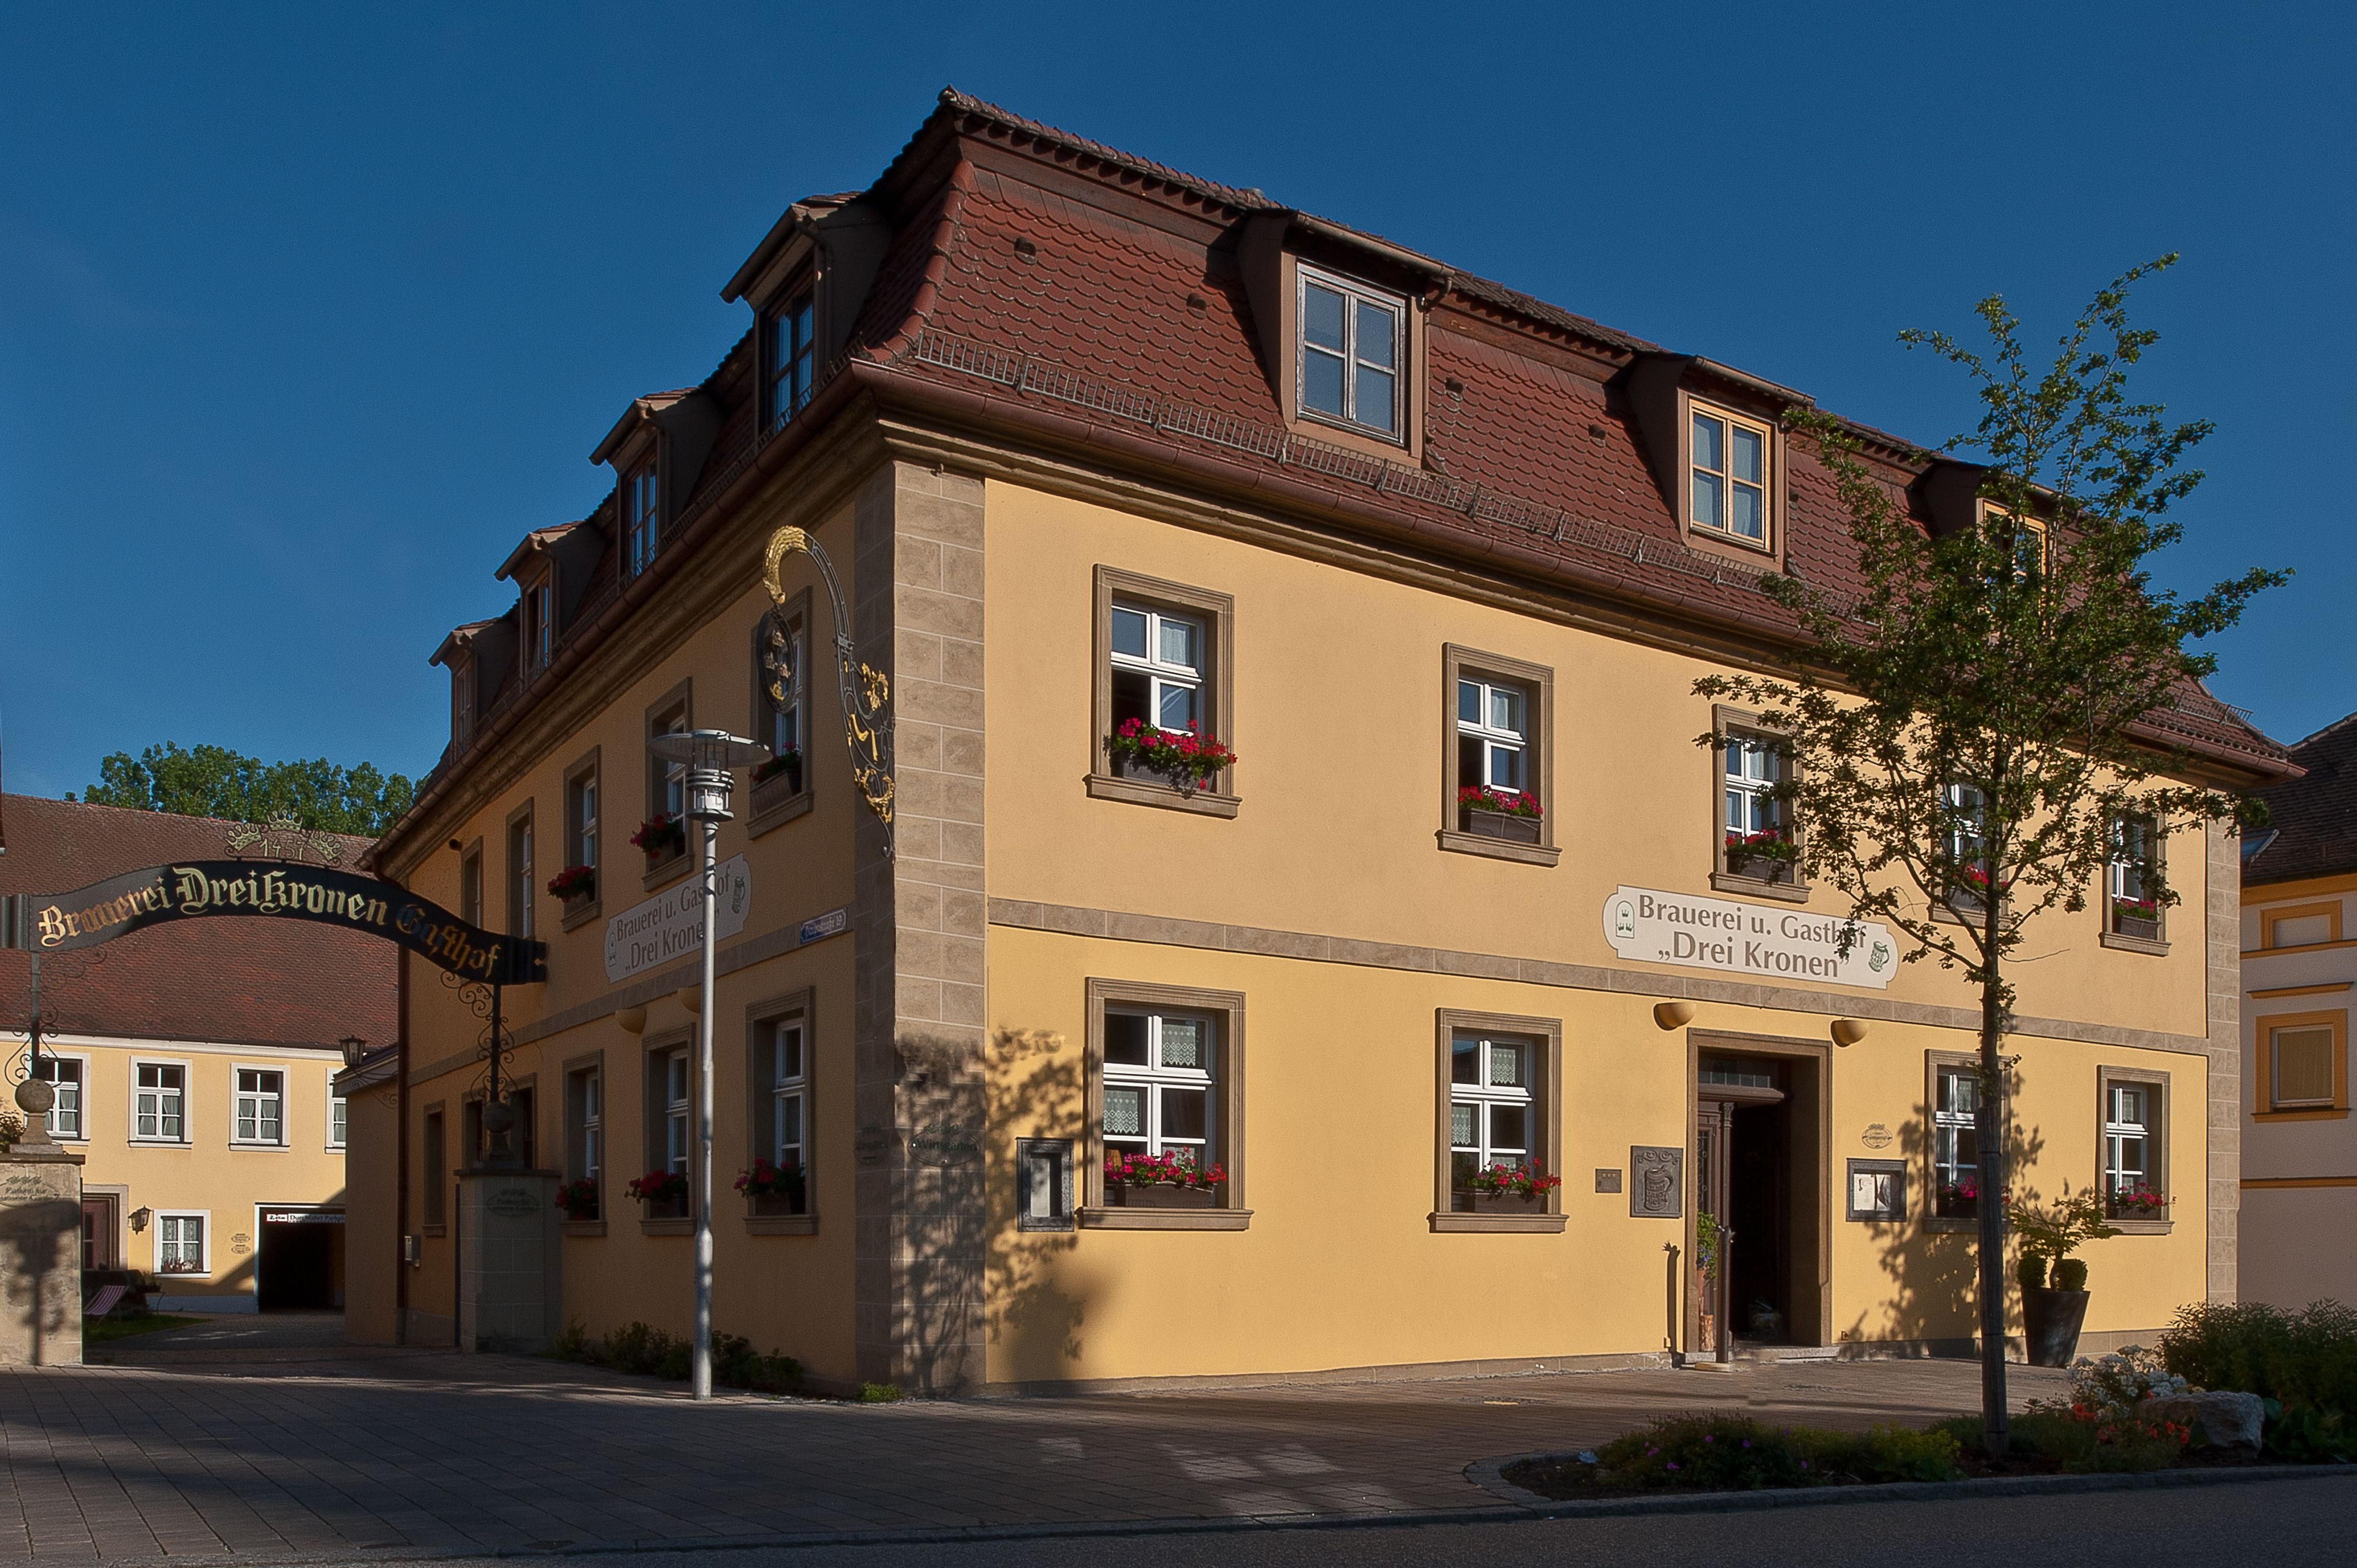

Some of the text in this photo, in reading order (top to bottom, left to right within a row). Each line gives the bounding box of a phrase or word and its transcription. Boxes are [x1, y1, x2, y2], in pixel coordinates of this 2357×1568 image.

[260, 838, 305, 861] 1457
[38, 876, 173, 947] Brauerei
[617, 864, 731, 942] Brauerei u. Gasof
[1639, 894, 1867, 948] Brauerei u. Gasthf
